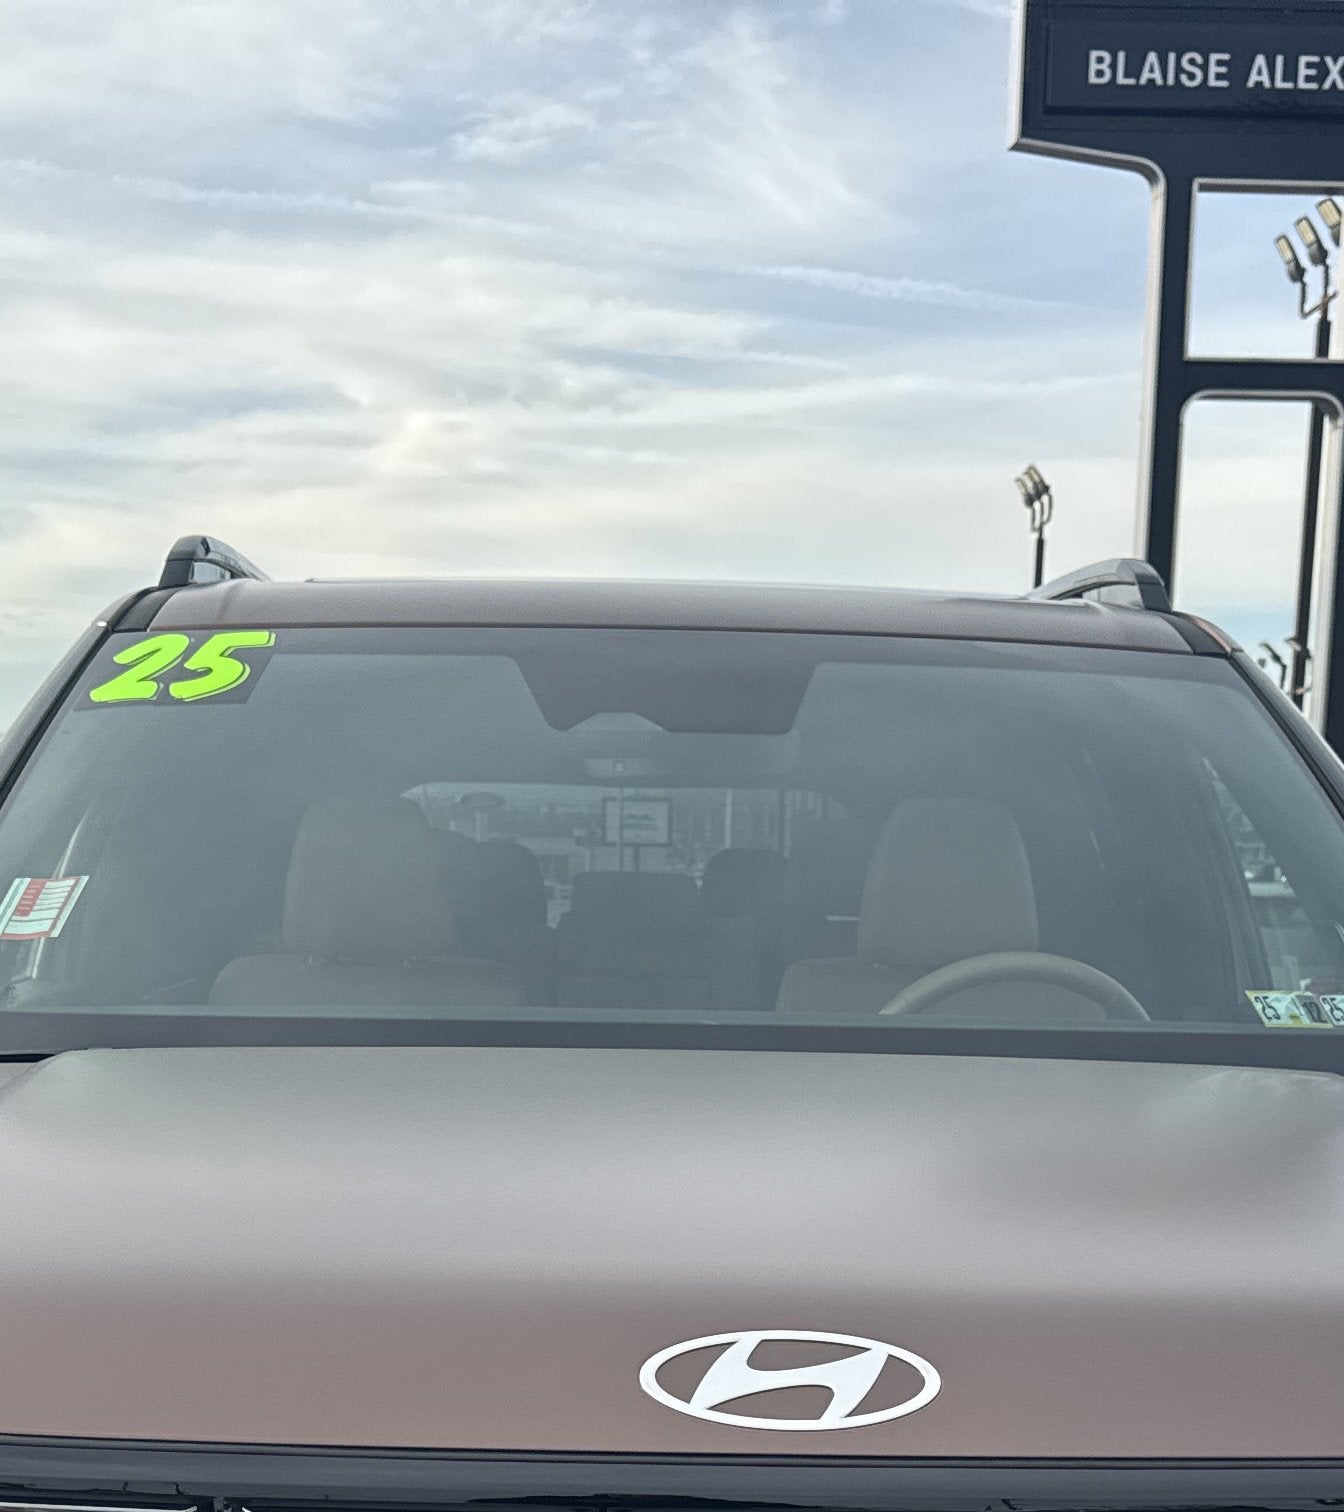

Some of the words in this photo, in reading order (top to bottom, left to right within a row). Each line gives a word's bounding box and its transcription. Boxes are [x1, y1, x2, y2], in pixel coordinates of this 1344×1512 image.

[1087, 49, 1231, 89] BLAISE
[89, 630, 276, 703] 25
[1254, 995, 1281, 1021] 25
[1301, 1001, 1328, 1023] 12
